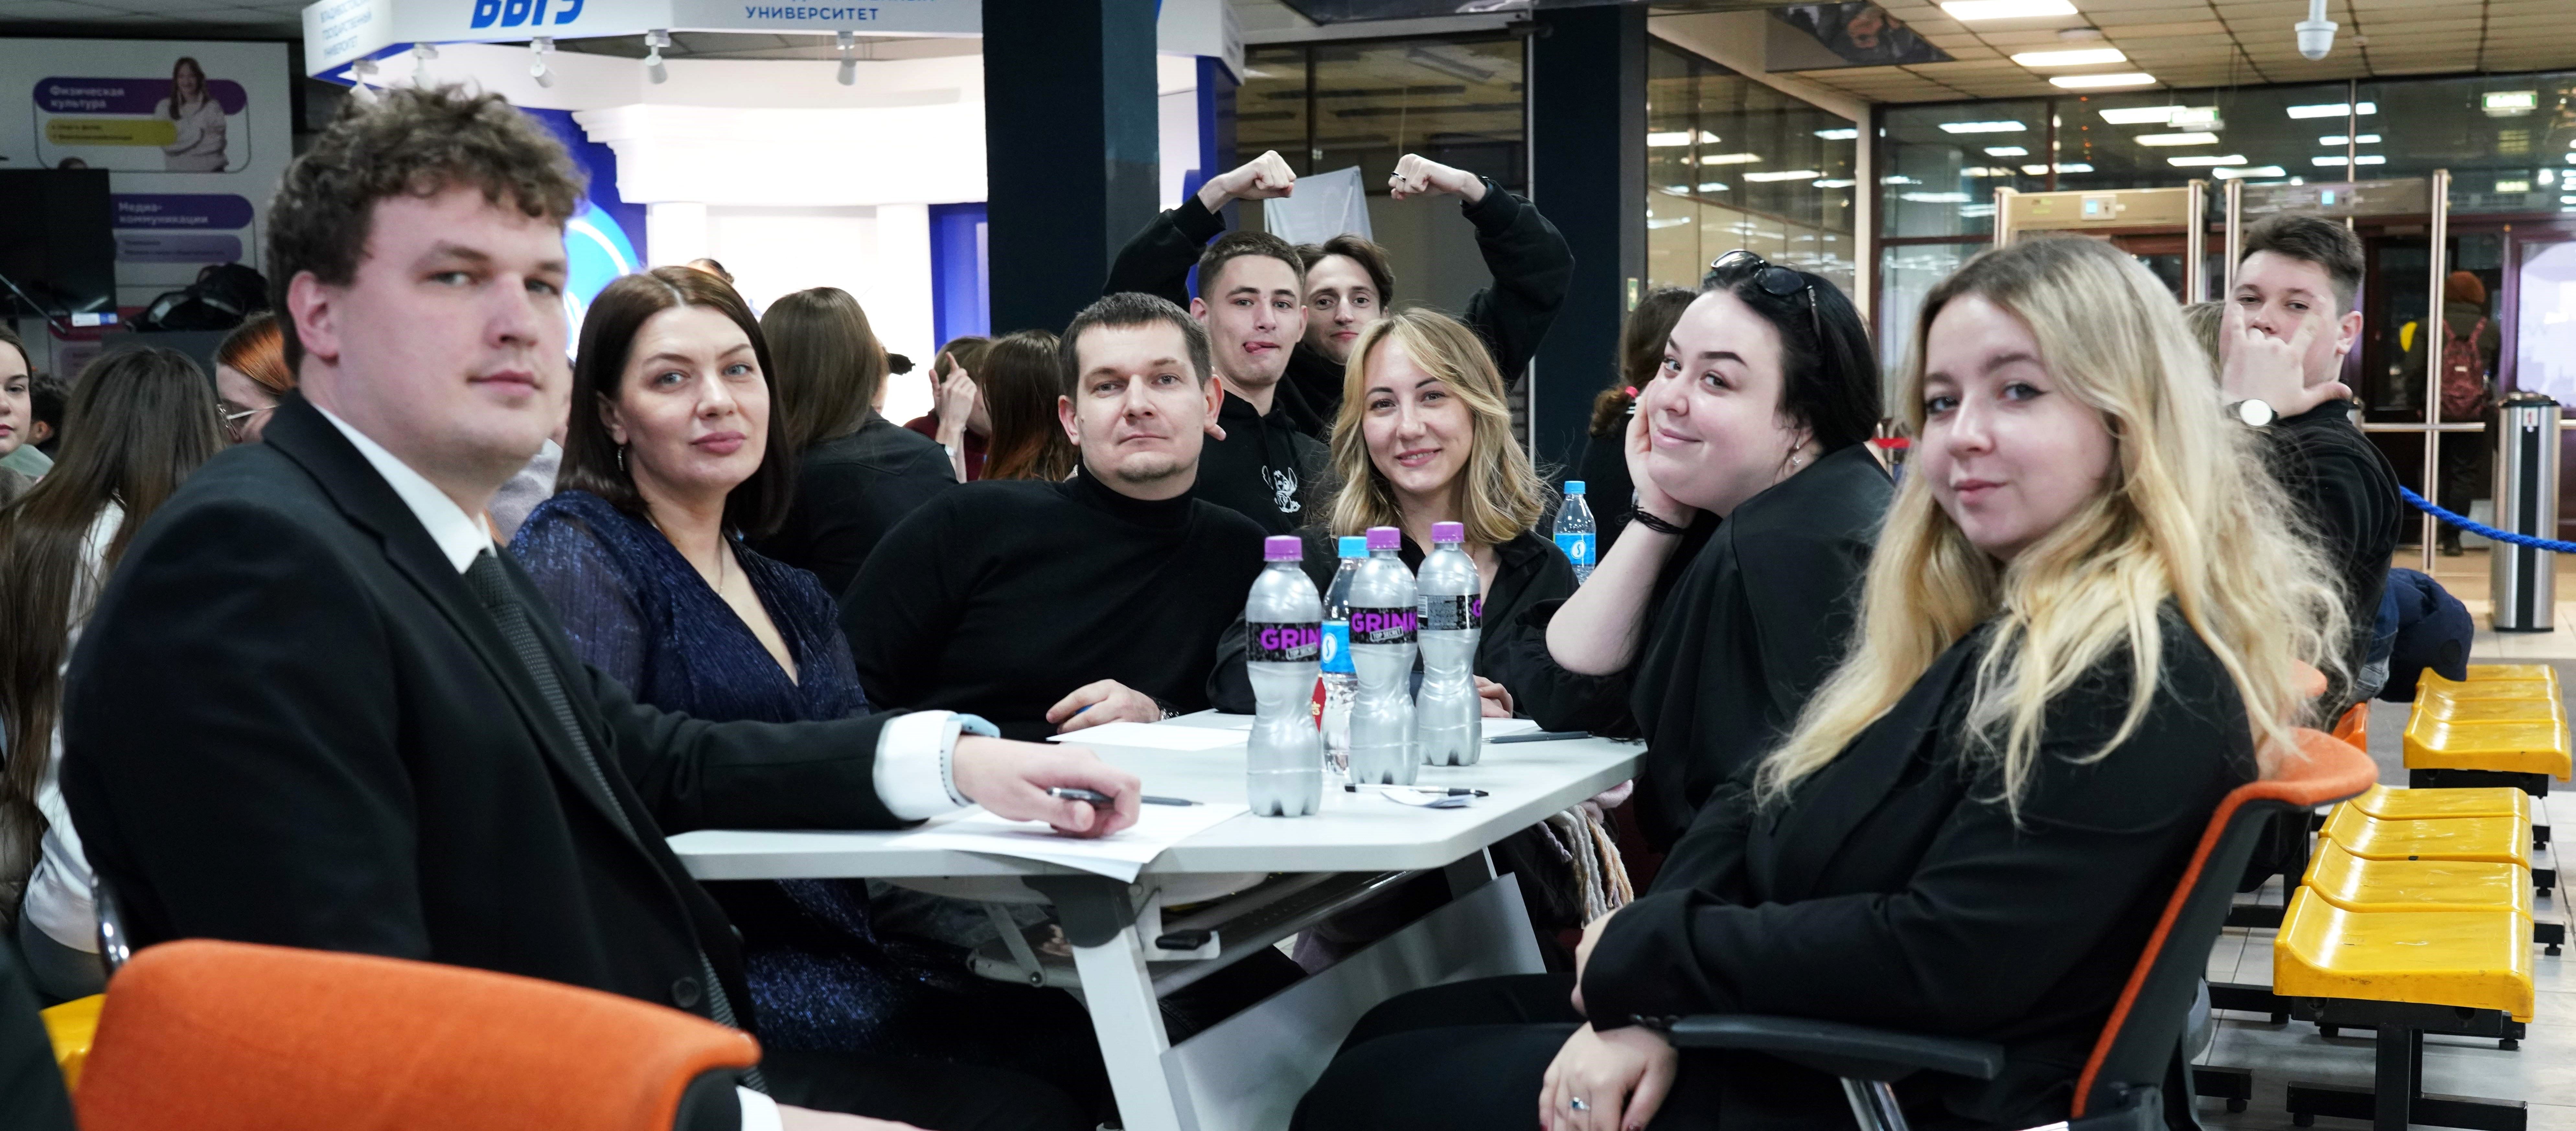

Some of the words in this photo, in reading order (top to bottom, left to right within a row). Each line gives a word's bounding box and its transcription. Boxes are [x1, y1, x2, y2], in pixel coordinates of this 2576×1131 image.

[745, 6, 879, 20] УНИВЕРСИТЕТ
[50, 85, 124, 97] Физическая
[50, 99, 107, 110] культура
[119, 215, 209, 226] коммуникации
